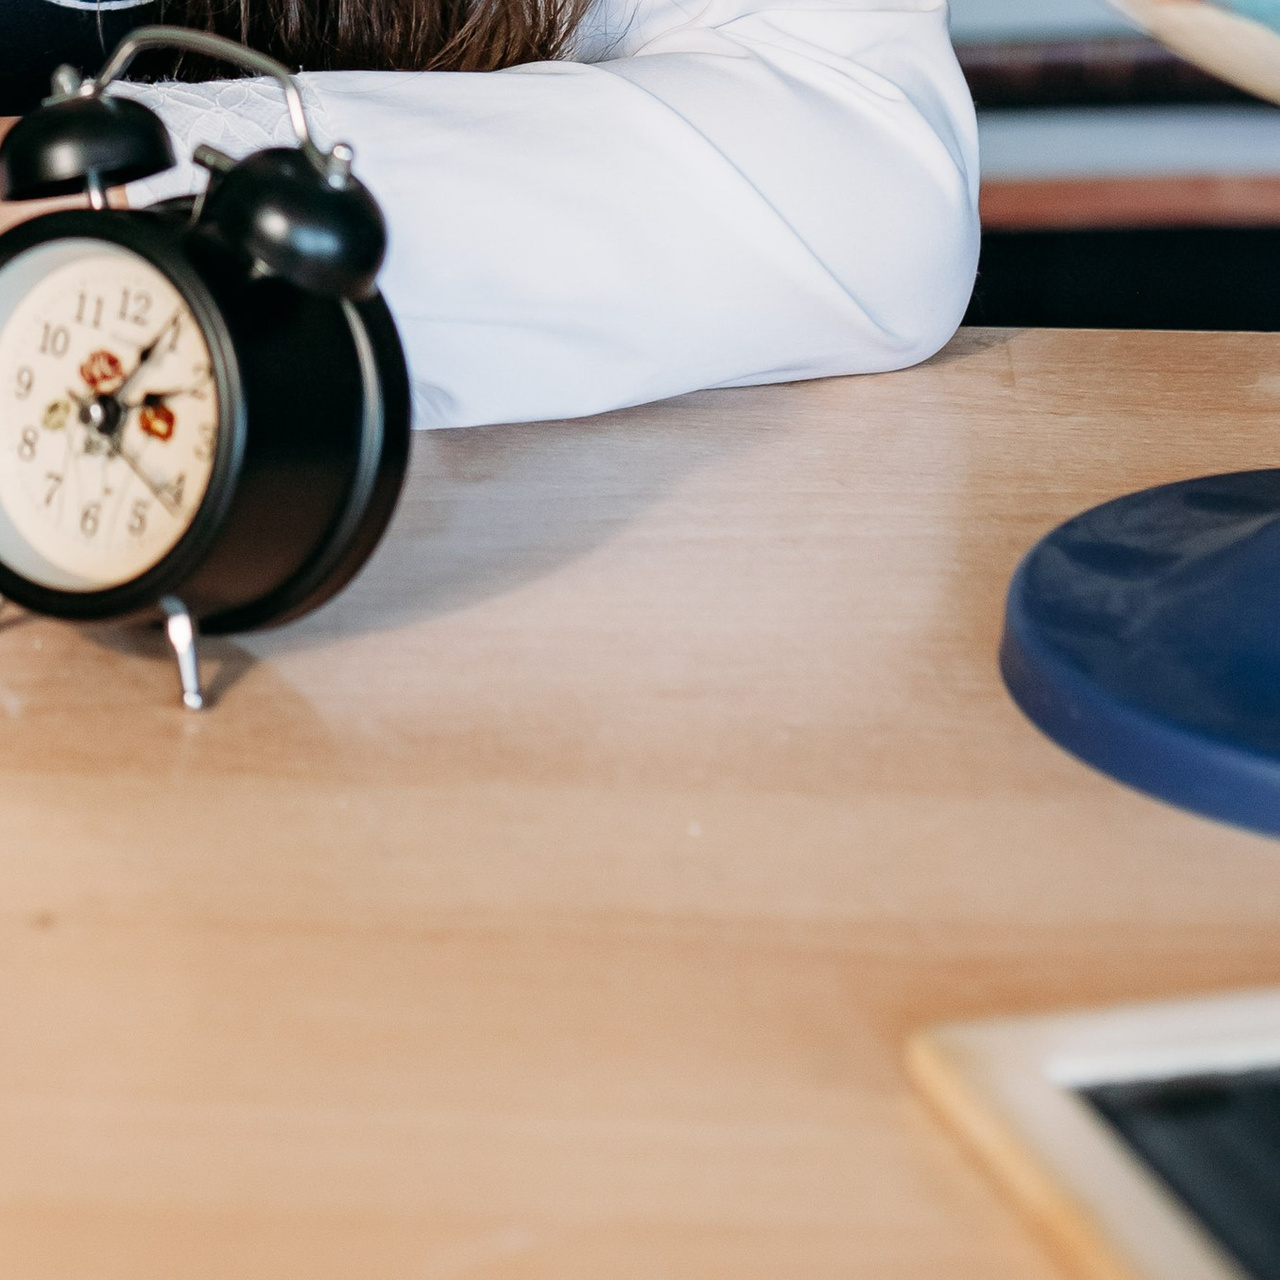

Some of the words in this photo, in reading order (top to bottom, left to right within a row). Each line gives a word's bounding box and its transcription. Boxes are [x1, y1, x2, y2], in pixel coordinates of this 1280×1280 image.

[75, 291, 104, 329] 11
[120, 288, 152, 326] 12
[39, 322, 70, 359] 10
[17, 366, 35, 400] 9
[19, 427, 39, 462] 8
[43, 471, 64, 507] 7
[79, 501, 102, 537] 6
[128, 500, 150, 536] 5
